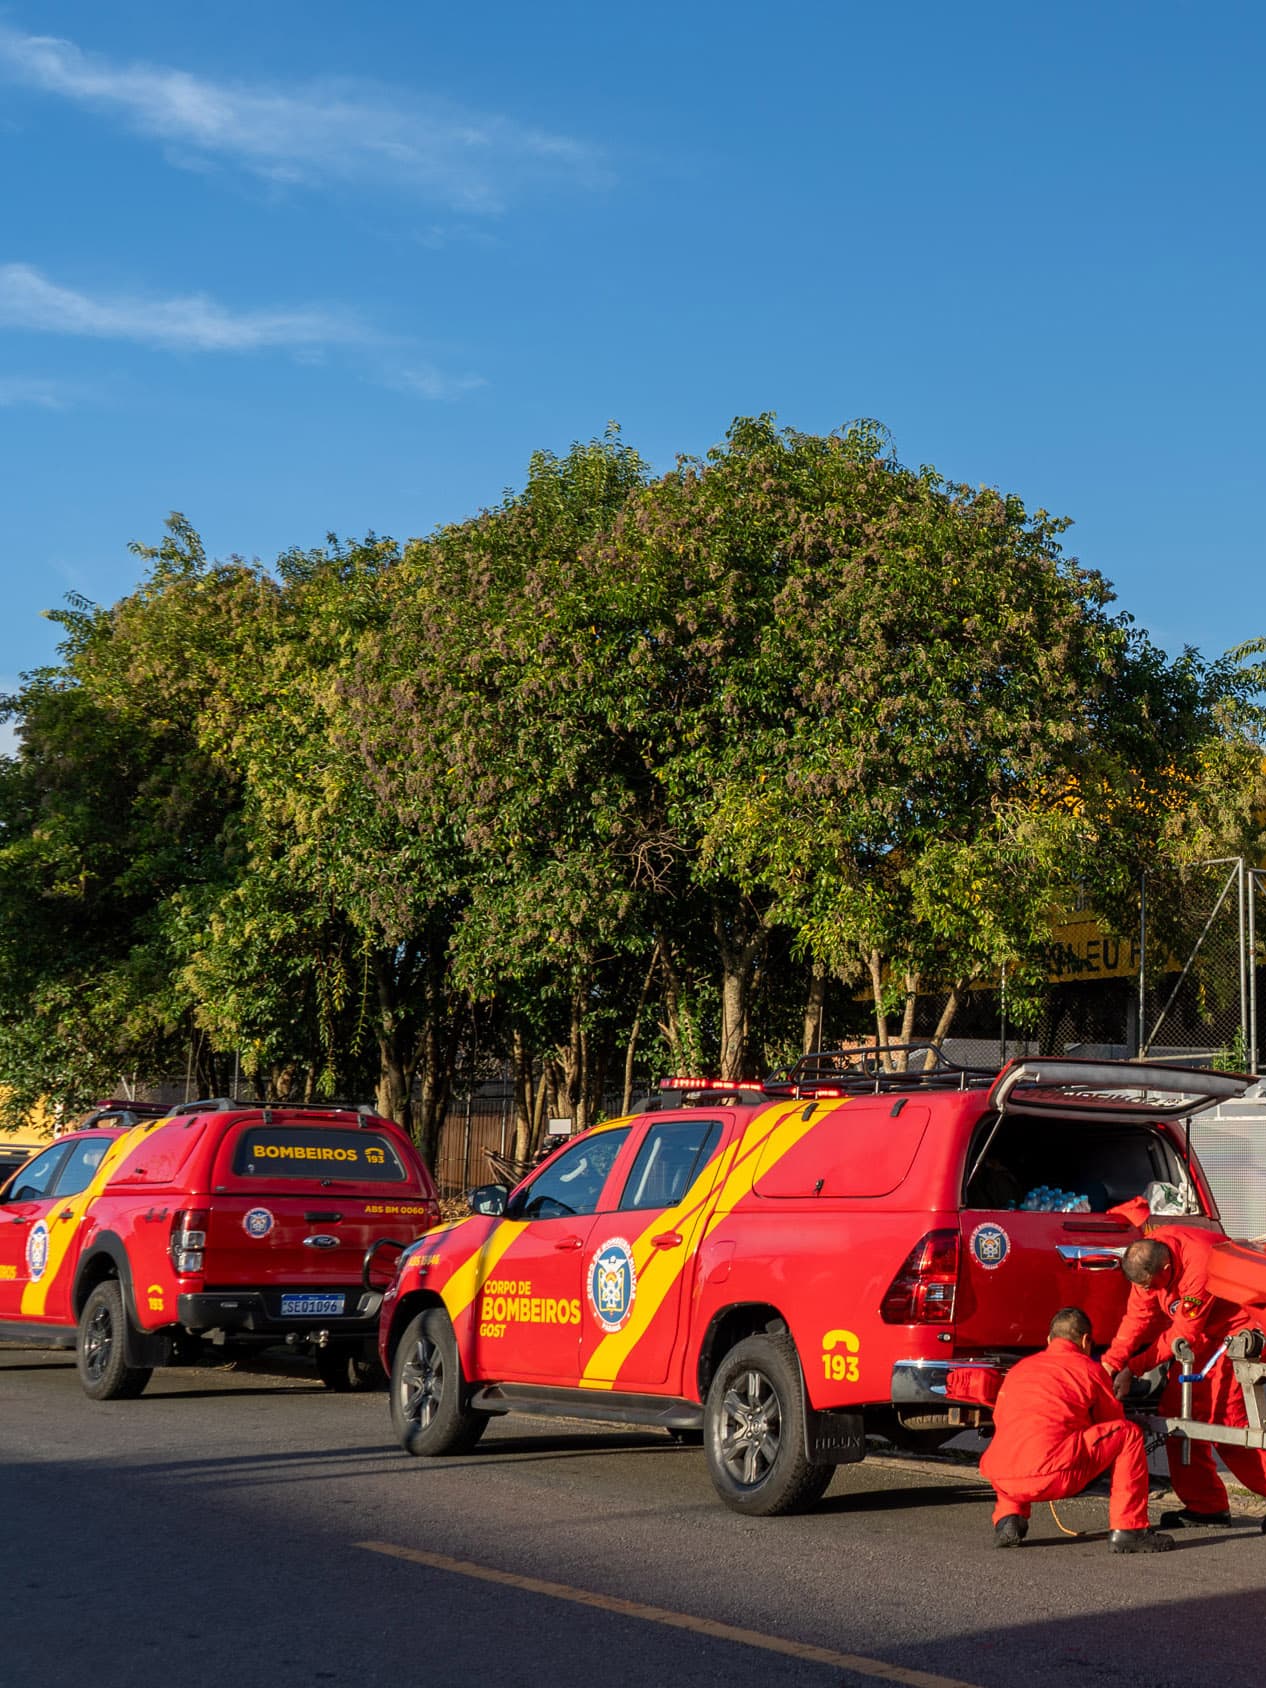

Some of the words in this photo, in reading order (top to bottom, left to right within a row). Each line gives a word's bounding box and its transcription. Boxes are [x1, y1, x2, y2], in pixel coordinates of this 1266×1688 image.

[253, 1145, 358, 1161] BOMBEIROS
[366, 1155, 385, 1164] 193
[364, 1205, 383, 1214] ABS
[385, 1206, 399, 1214] BM
[484, 1280, 516, 1295] CORPO
[518, 1281, 531, 1295] DE
[481, 1297, 581, 1324] BOMBEIROS
[479, 1323, 506, 1337] GOST
[822, 1354, 859, 1382] 193
